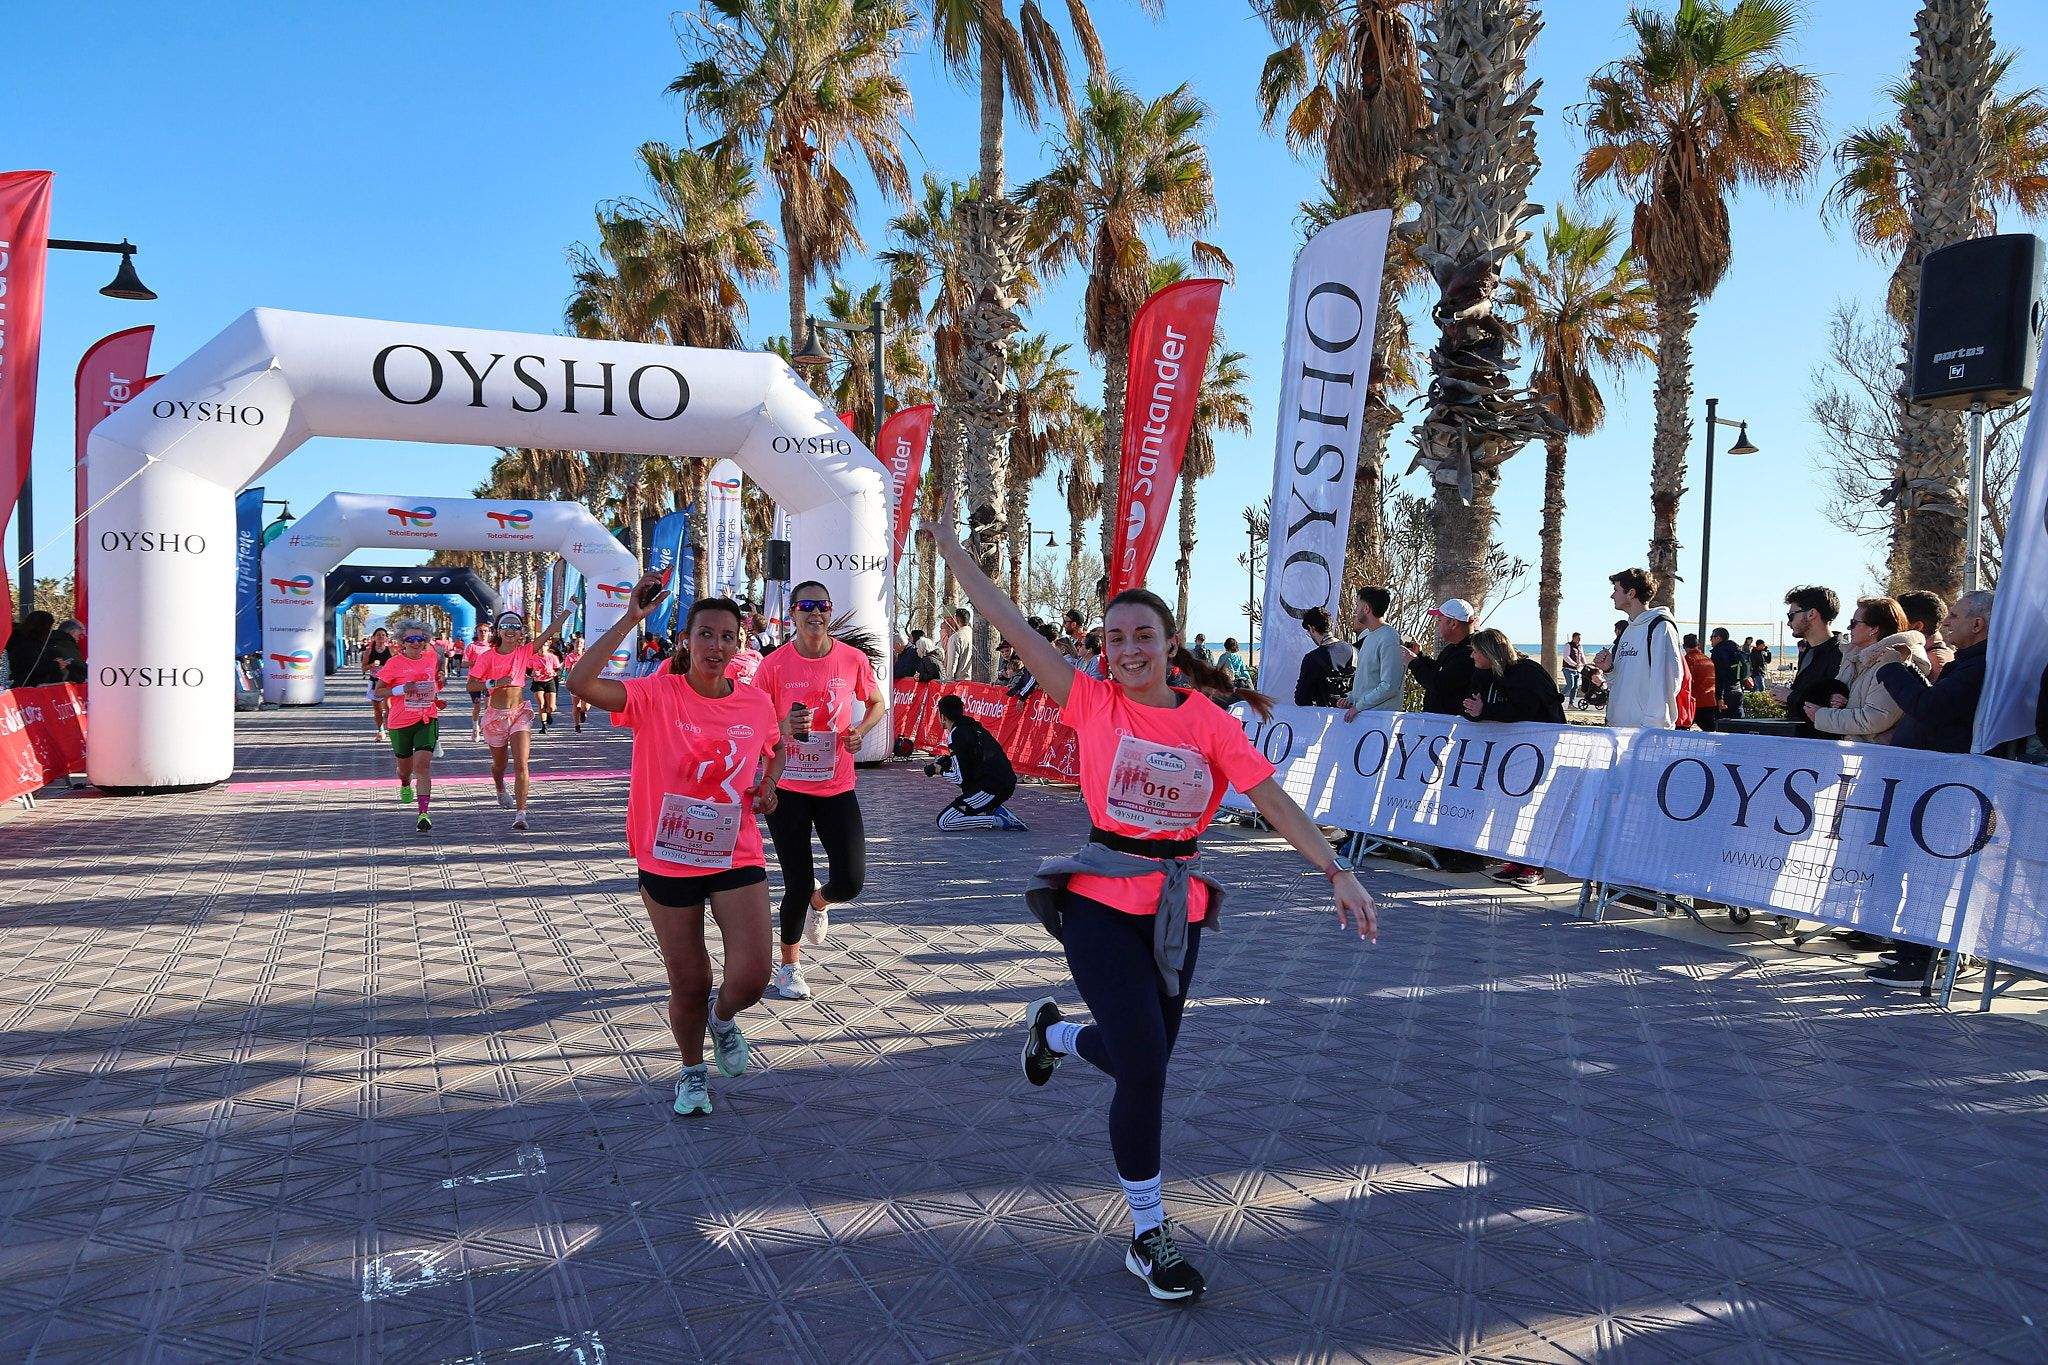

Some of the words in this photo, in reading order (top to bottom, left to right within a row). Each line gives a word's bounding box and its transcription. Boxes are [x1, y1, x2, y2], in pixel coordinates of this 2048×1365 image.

[373, 344, 690, 421] OYSHO
[152, 400, 265, 426] OYSHO
[1134, 325, 1187, 496] Santander
[772, 436, 851, 455] OYSHO
[1280, 281, 1363, 620] OYSHO
[101, 531, 206, 554] OYSHO
[388, 530, 437, 538] TotalEnergies
[816, 553, 888, 571] OYSHO
[361, 575, 451, 584] VOLVO
[100, 666, 204, 688] OYSHO
[799, 753, 820, 762] 016
[1353, 729, 1545, 797] OYSHO
[1143, 781, 1179, 801] 016
[1115, 809, 1144, 822] OYSHO
[1657, 758, 1997, 859] OYSHO
[685, 828, 714, 842] 016
[1722, 849, 1875, 887] WWW.OYSHO.COM
